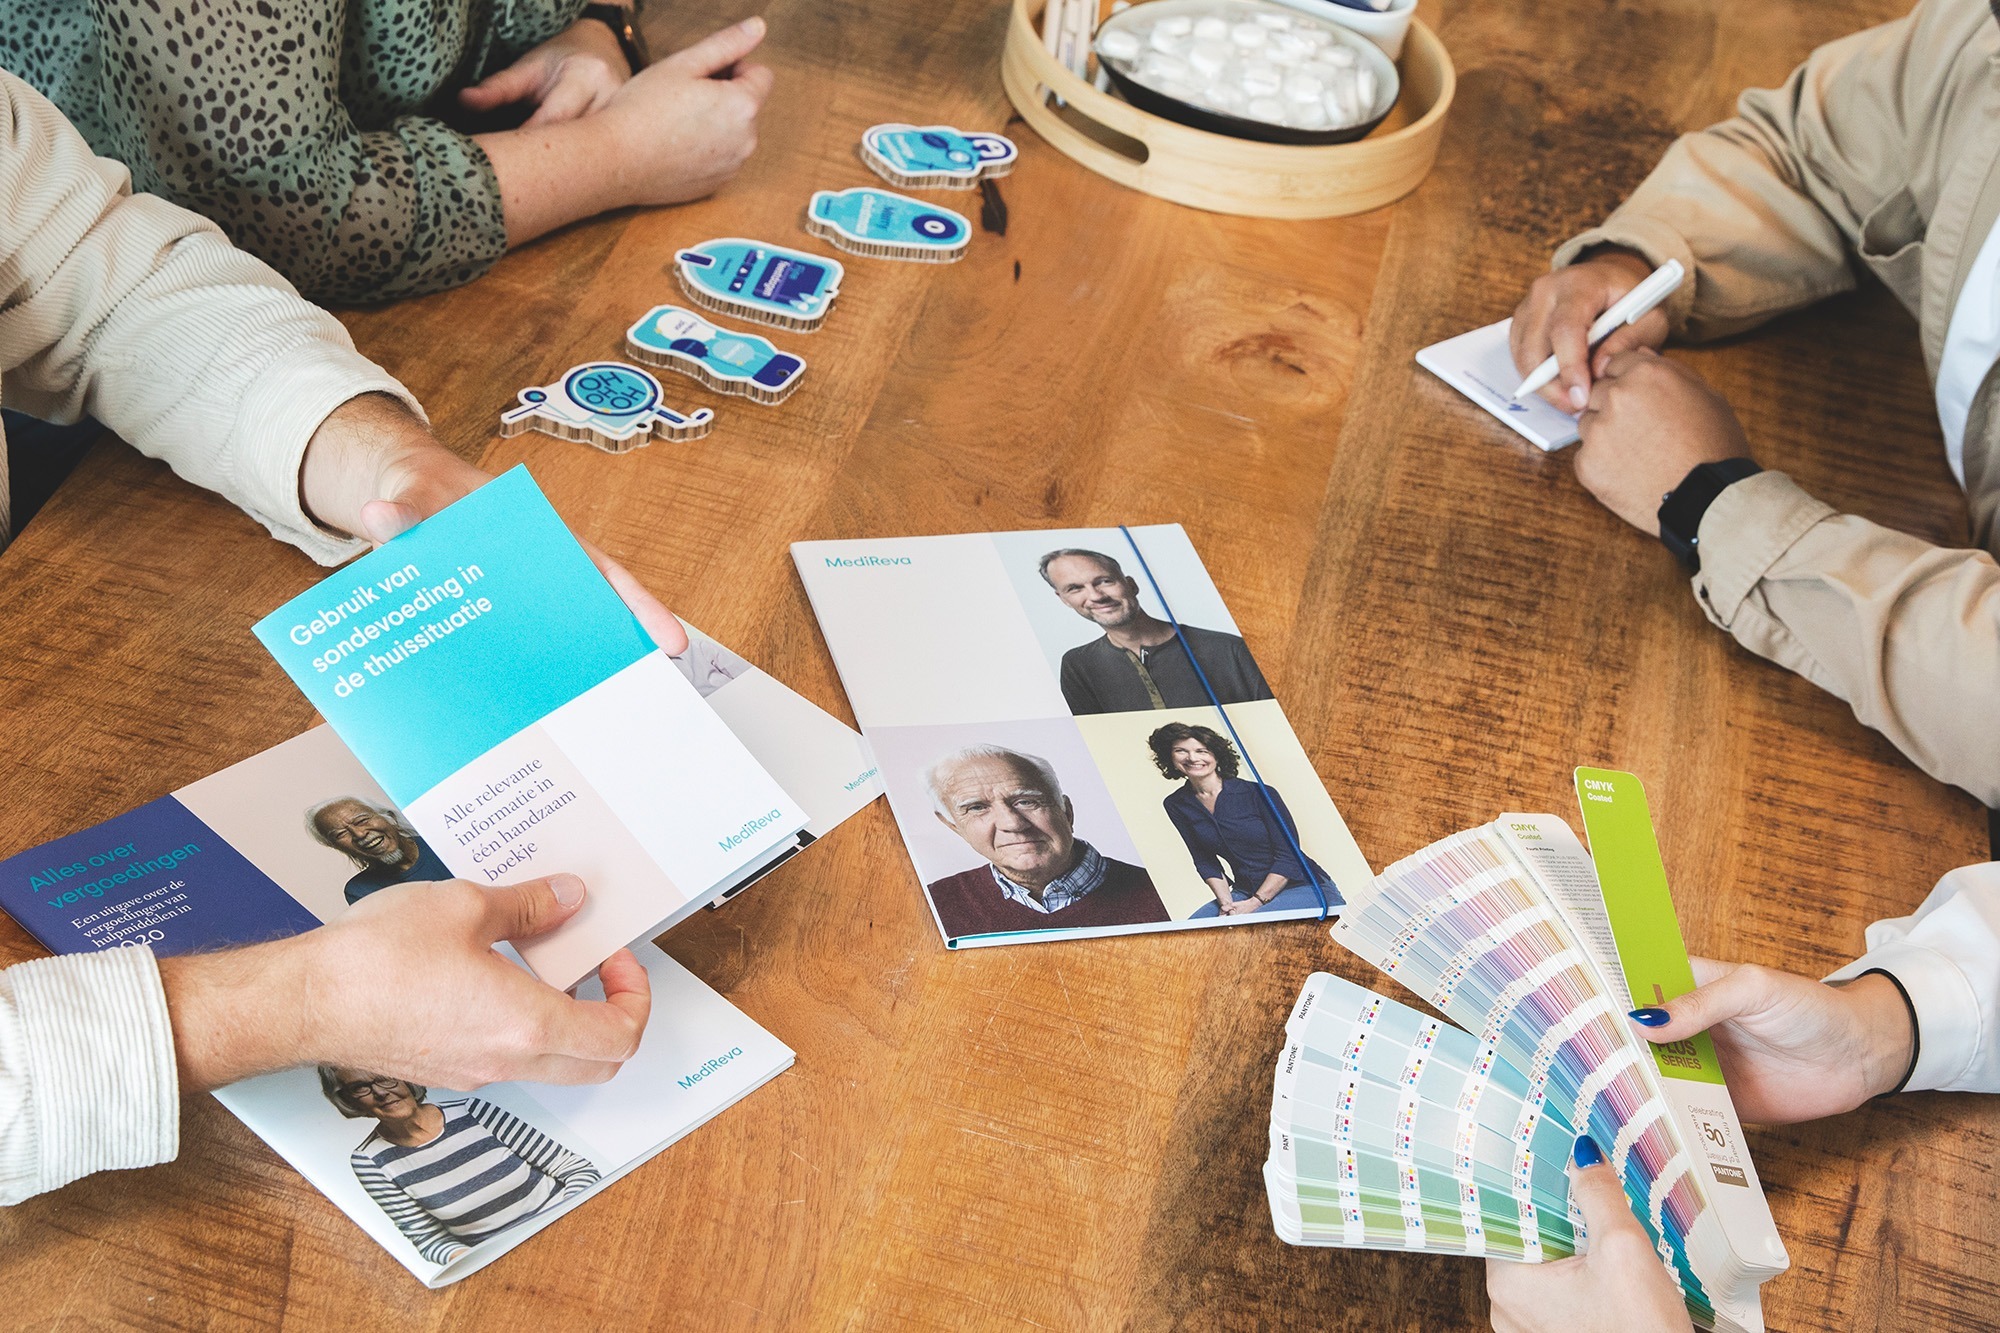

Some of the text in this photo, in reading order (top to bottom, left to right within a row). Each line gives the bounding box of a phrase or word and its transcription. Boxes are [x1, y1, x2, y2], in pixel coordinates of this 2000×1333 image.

[578, 371, 624, 391] HO
[585, 386, 618, 405] HO
[610, 385, 647, 410] HO
[825, 556, 912, 568] MediReva
[290, 564, 421, 646] Gebruik van
[313, 564, 485, 673] sondevoeding in
[334, 597, 493, 698] de thuissituatie
[443, 759, 543, 829] Alle relevante
[843, 766, 878, 792] MediRev
[1584, 779, 1615, 793] CMYK
[455, 778, 555, 846] informatie in
[1587, 792, 1613, 803] Coated
[472, 790, 577, 864] één handzaam
[718, 808, 782, 853] MediReva
[1510, 823, 1539, 832] CMYK
[1517, 833, 1542, 841] Coated
[28, 841, 137, 893] Alles over
[47, 842, 201, 909] vergoedingen
[483, 842, 538, 882] boekje
[71, 878, 186, 930] Een uitgave over de
[83, 891, 188, 938] vergoedingen van
[92, 903, 192, 948] hulpmiddelen in
[1299, 993, 1314, 1020] PANTONE
[1286, 1045, 1298, 1075] PANTONE
[1656, 1040, 1697, 1056] PLUS
[1660, 1054, 1702, 1070] SERIES
[677, 1046, 743, 1090] MediReva
[1703, 1122, 1726, 1148] 50
[1712, 1166, 1744, 1179] PANTONE
